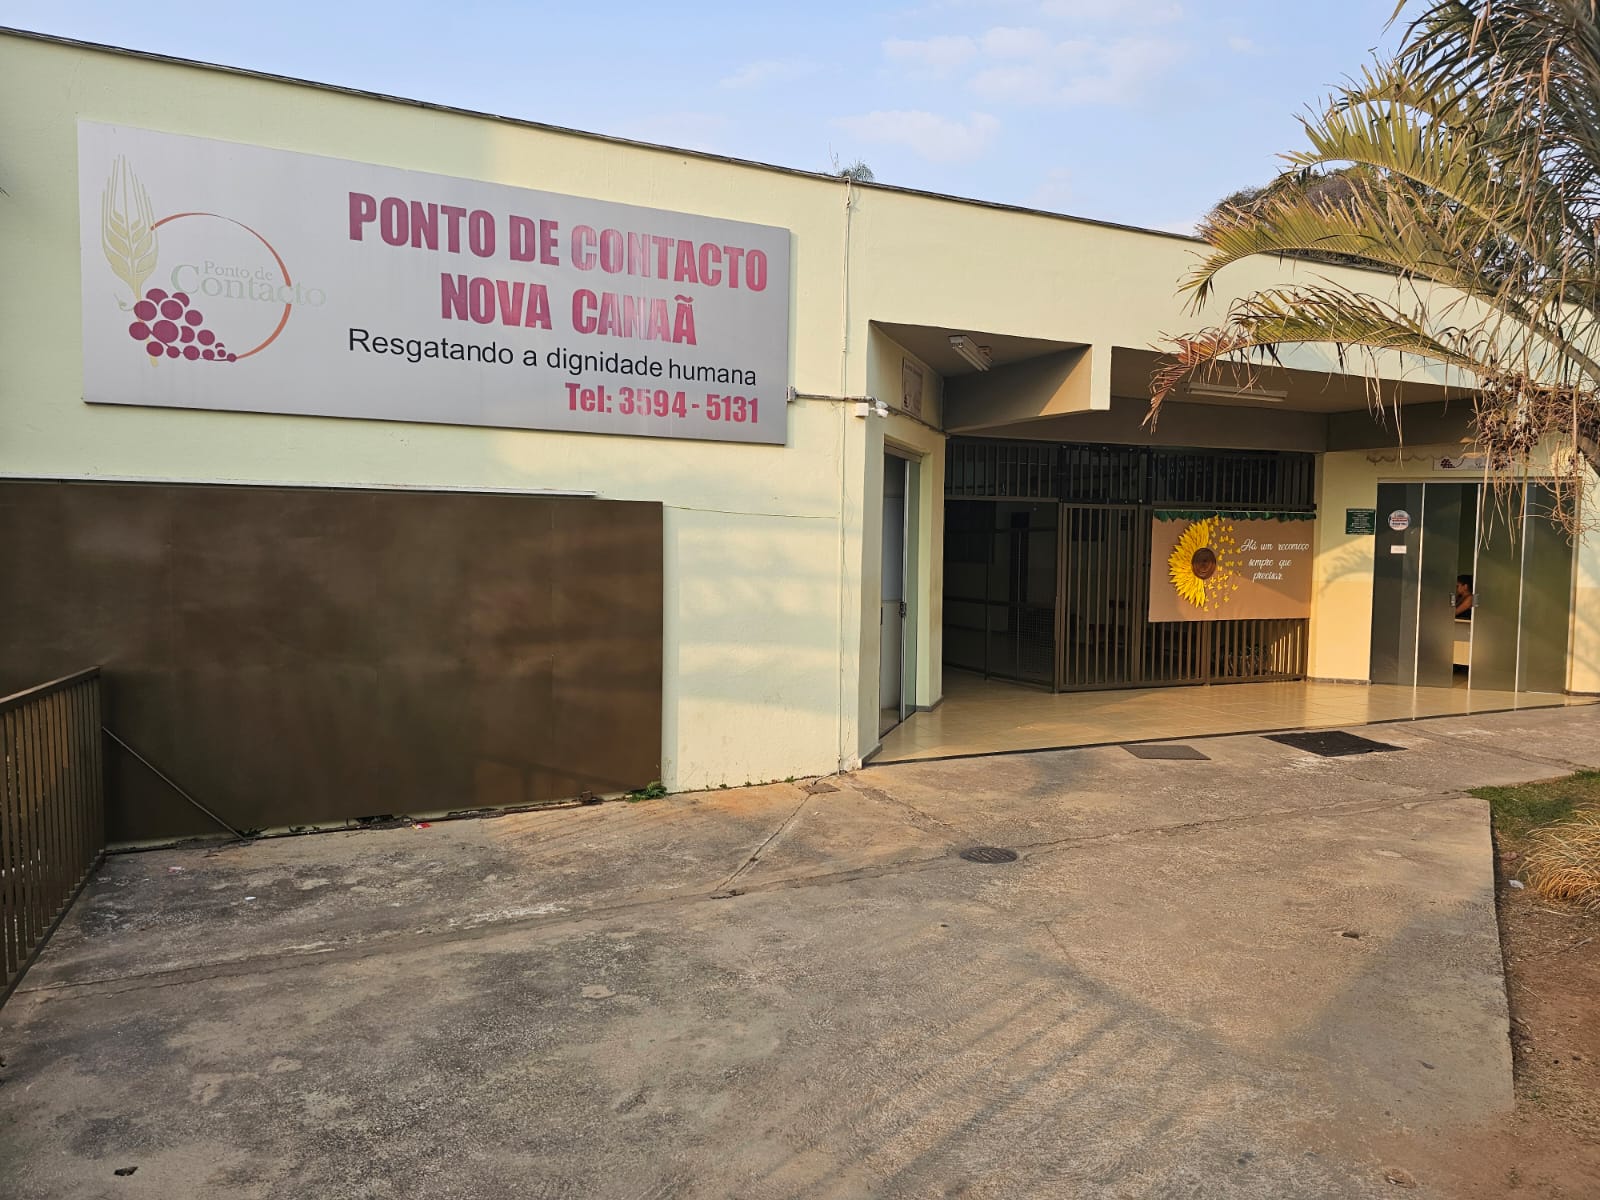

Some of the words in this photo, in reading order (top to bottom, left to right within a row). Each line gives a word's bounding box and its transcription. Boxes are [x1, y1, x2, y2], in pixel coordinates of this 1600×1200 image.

[349, 191, 496, 258] PONTO
[508, 214, 559, 266] DE
[571, 224, 768, 292] CONTACTO
[171, 264, 326, 306] Contacto
[203, 260, 251, 279] Ponto
[254, 265, 273, 281] de
[441, 272, 552, 330] NOVA
[571, 288, 697, 345] CANAÃ
[349, 327, 514, 366] Resgatando
[523, 349, 538, 367] a
[546, 347, 663, 377] dignidade
[669, 358, 757, 386] humana
[565, 382, 612, 414] Tel:
[618, 386, 687, 418] 3594
[706, 394, 758, 423] 5131
[1240, 538, 1258, 552] Há
[1260, 543, 1274, 551] um
[1278, 542, 1310, 552] recomeço
[1248, 558, 1274, 569] sempre
[1278, 559, 1292, 569] que
